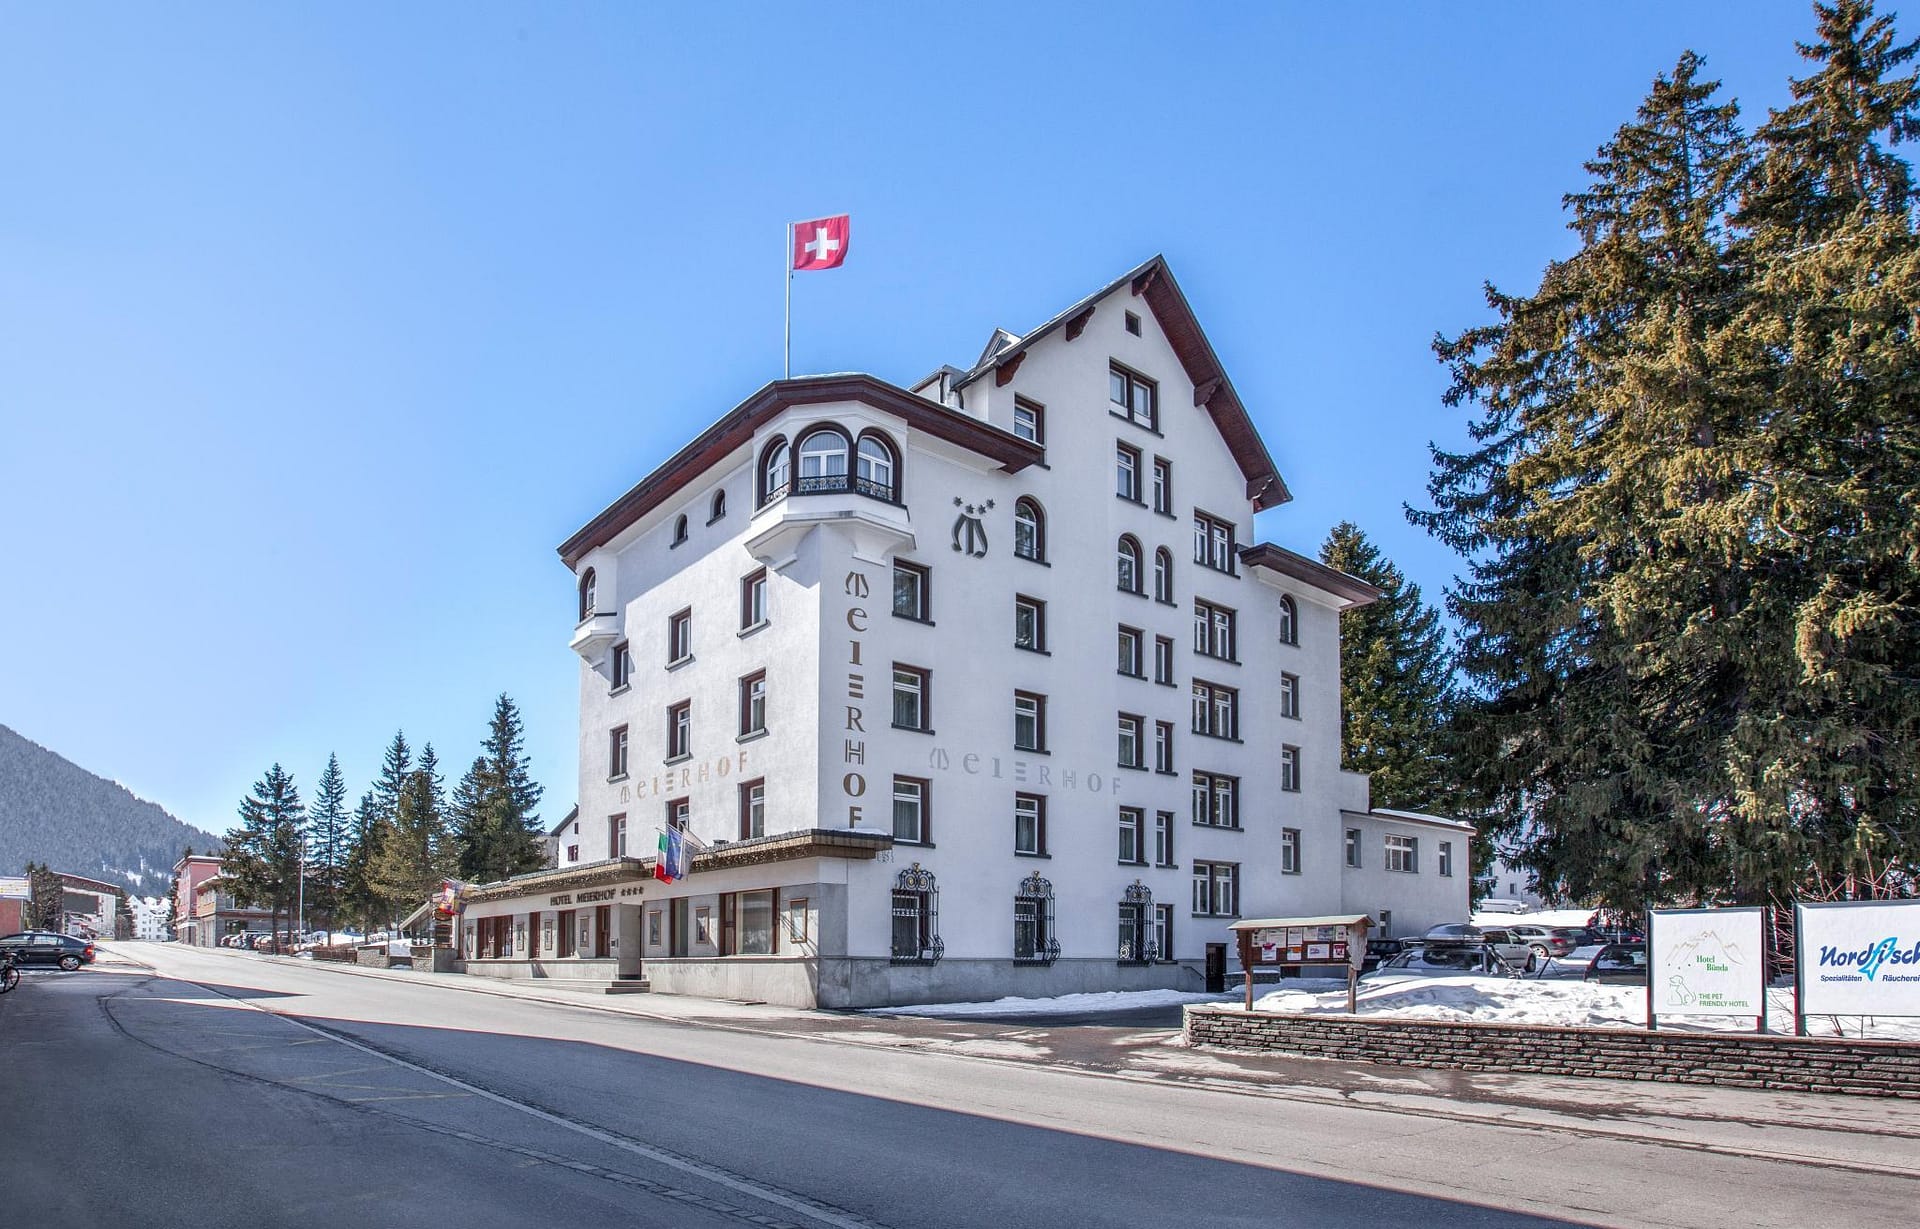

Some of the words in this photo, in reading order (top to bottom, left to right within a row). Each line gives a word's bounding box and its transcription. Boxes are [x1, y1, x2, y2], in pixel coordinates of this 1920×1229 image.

[550, 894, 572, 906] HOTEL
[576, 888, 616, 903] MEIERHOF
[1696, 955, 1715, 963] Hotel
[1820, 974, 1863, 982] Spezialitäten
